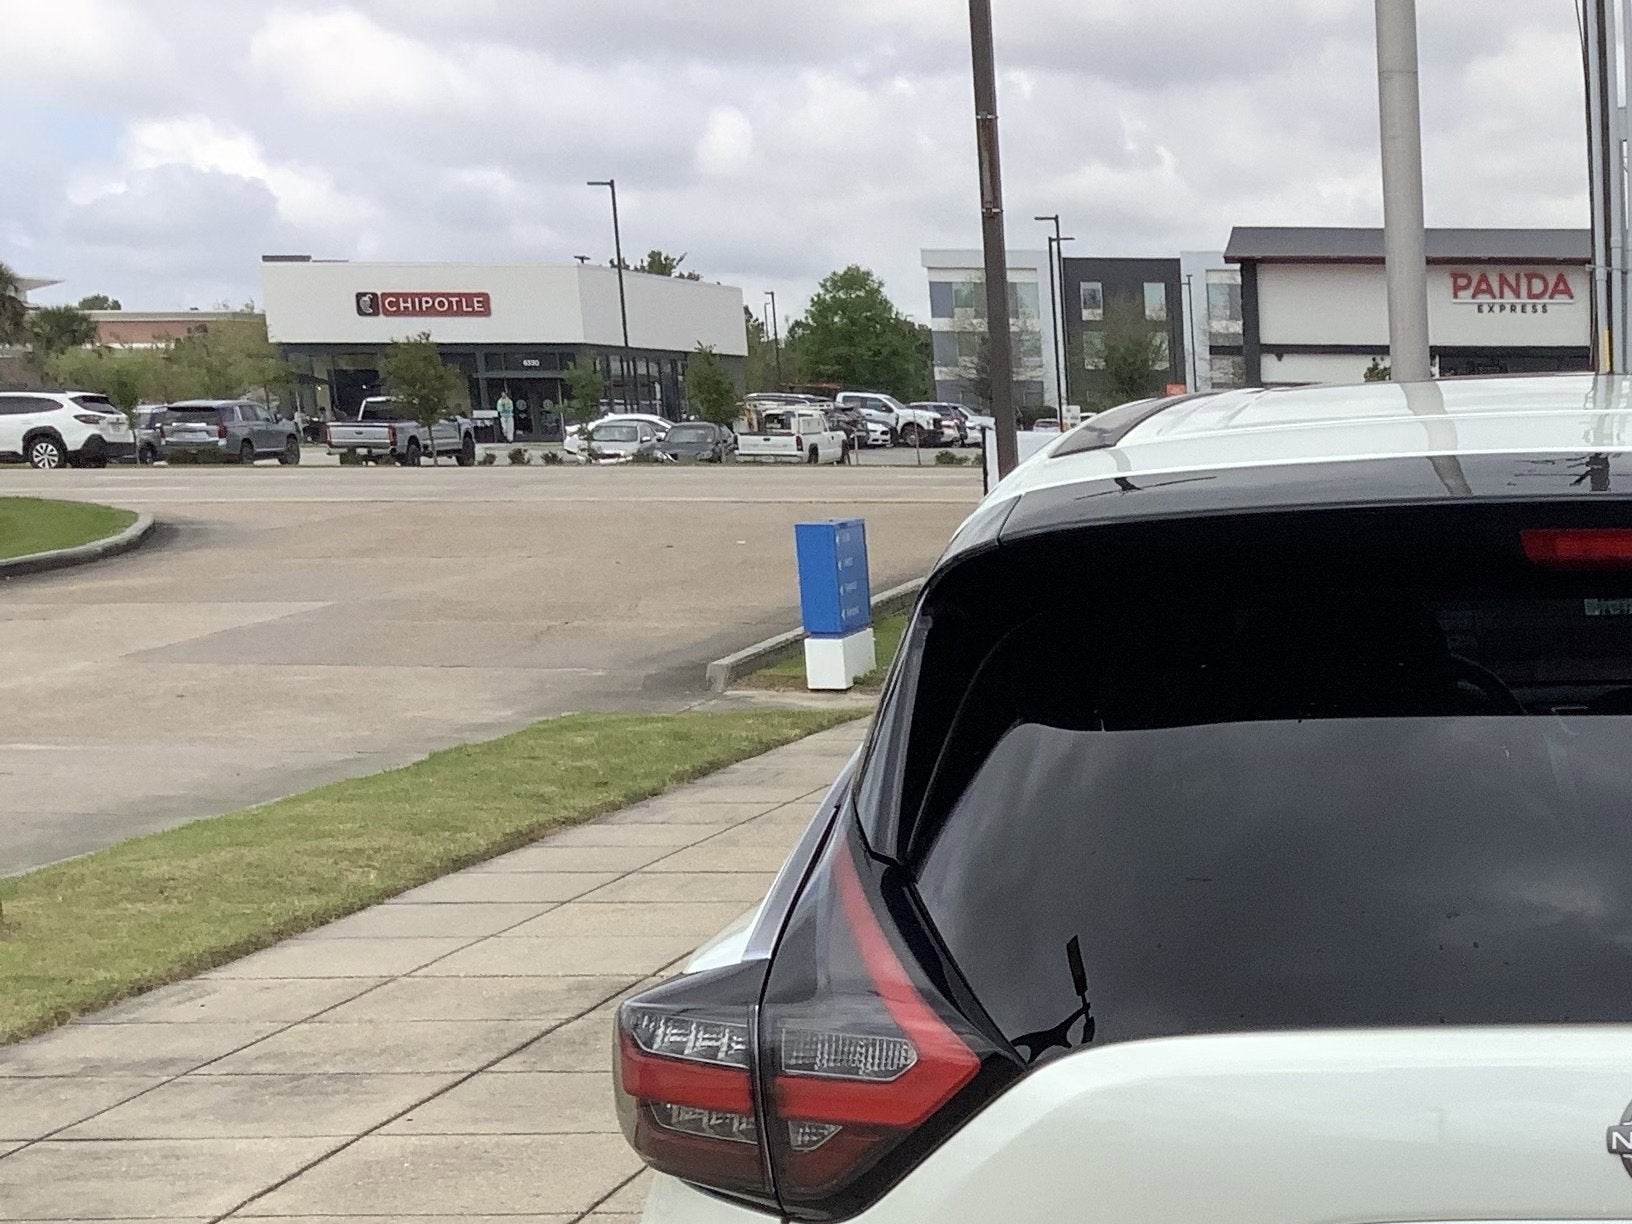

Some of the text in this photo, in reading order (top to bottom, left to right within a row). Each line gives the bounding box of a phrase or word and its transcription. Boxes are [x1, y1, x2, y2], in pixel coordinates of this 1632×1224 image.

[1450, 271, 1575, 300] PANDA
[384, 297, 485, 312] CHIPOTLE
[1477, 304, 1548, 314] EXPRESS
